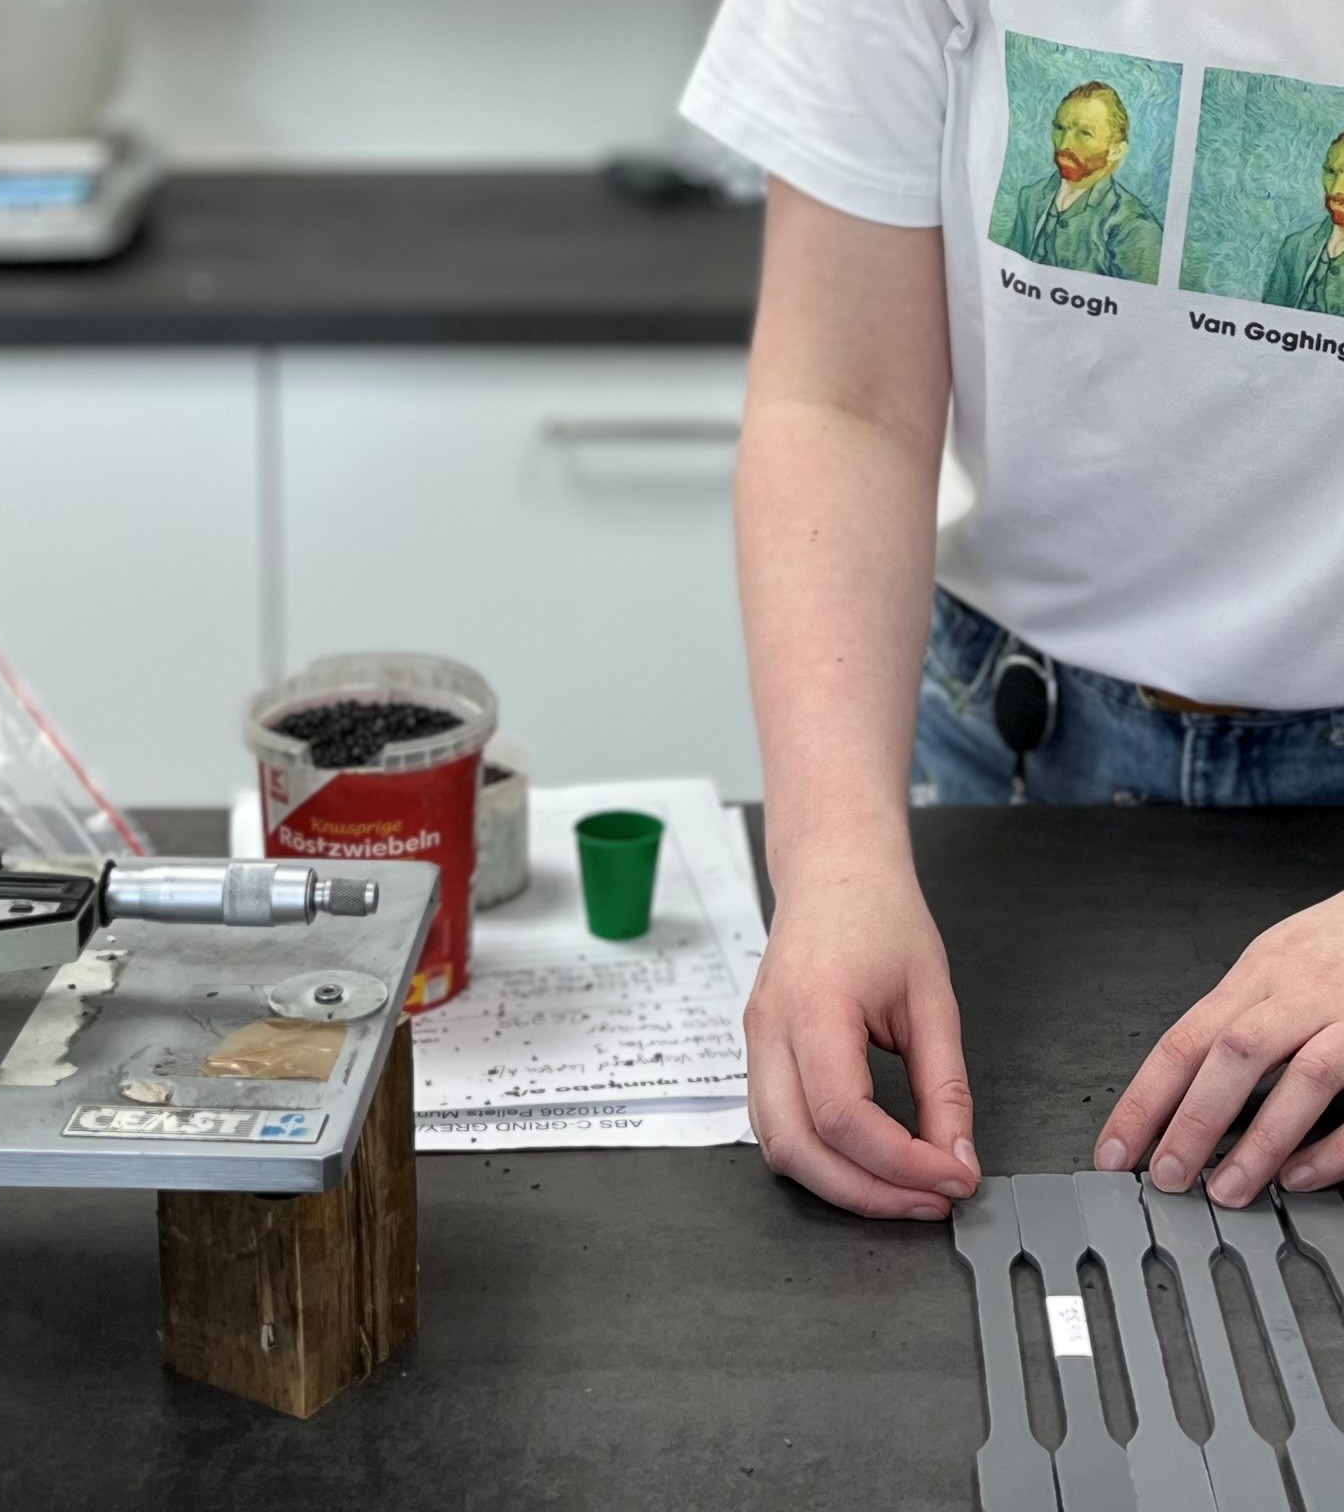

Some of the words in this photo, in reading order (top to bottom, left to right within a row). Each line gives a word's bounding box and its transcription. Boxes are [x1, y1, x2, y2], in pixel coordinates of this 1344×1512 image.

[1000, 268, 1041, 300] Van
[1050, 287, 1118, 316] Gogh
[1189, 311, 1236, 337] Van
[309, 817, 404, 835] Knusprige
[278, 823, 440, 858] Röstzwiebeln
[467, 1107, 533, 1117] Pellets
[540, 1104, 627, 1117] 2010206
[79, 1107, 251, 1134] CEAST
[496, 1120, 592, 1131] C-GRIND
[599, 1119, 644, 1129] ABS
